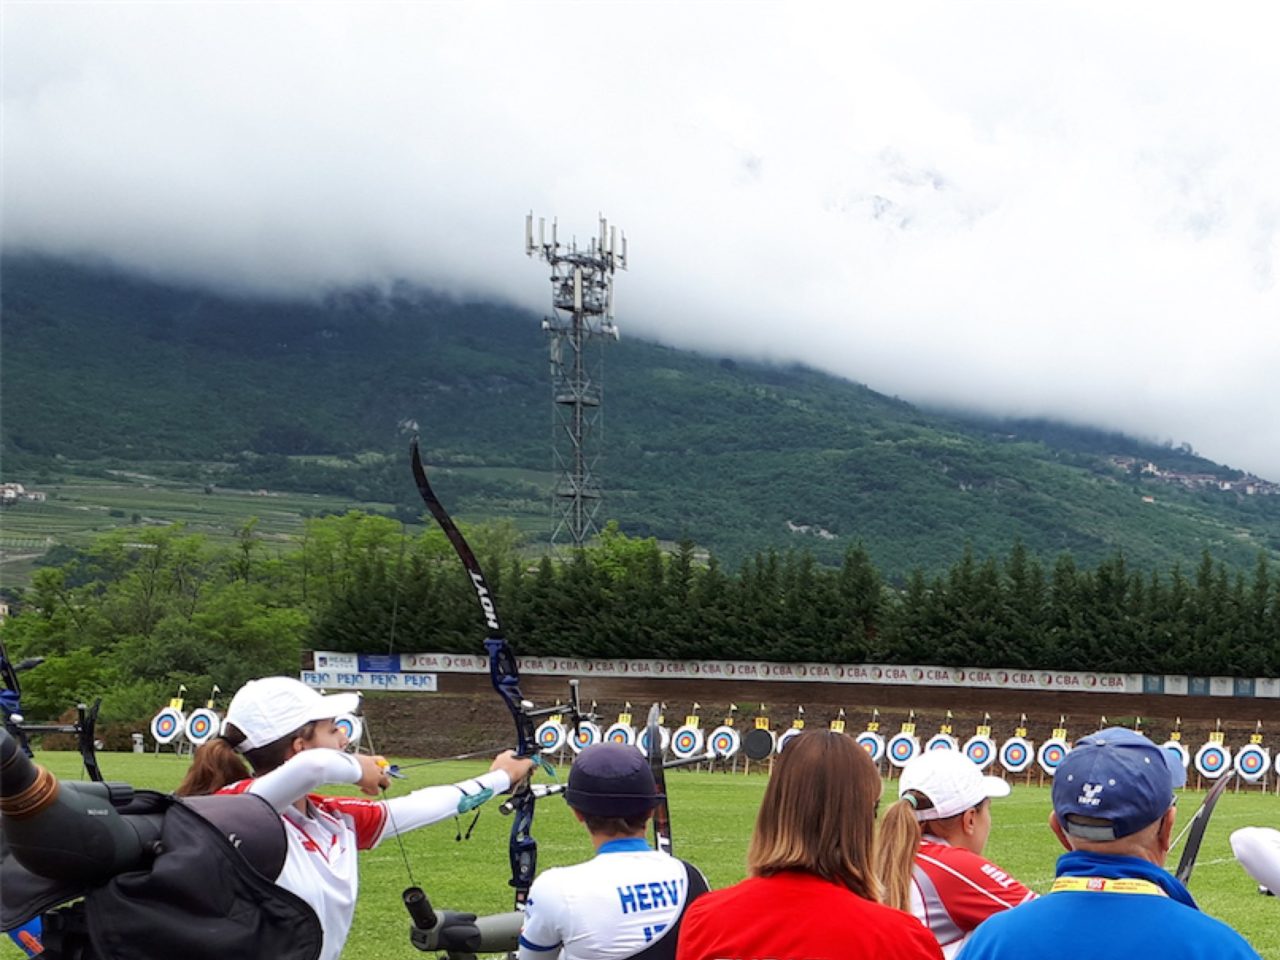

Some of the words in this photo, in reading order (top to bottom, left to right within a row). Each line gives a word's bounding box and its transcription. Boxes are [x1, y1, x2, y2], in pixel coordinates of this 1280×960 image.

[469, 569, 499, 629] HOYT
[419, 656, 437, 666] CBA
[453, 657, 473, 667] CBA
[525, 657, 543, 667] CBA
[560, 658, 578, 669] CBA
[595, 659, 614, 670] CBA
[631, 661, 649, 671] CBA
[667, 662, 686, 672] CBA
[702, 663, 721, 674] CBA
[738, 664, 756, 675] CBA
[773, 665, 792, 675] CBA
[810, 666, 829, 676] CBA
[847, 667, 867, 677] CBA
[885, 668, 907, 678] CBA
[927, 669, 948, 680] CBA
[969, 671, 992, 681] CBA
[1012, 672, 1035, 683] CBA
[1056, 674, 1079, 685] CBA
[1100, 676, 1123, 686] CBA
[868, 723, 879, 731] 22
[941, 725, 952, 734] 24
[1250, 735, 1262, 744] 32
